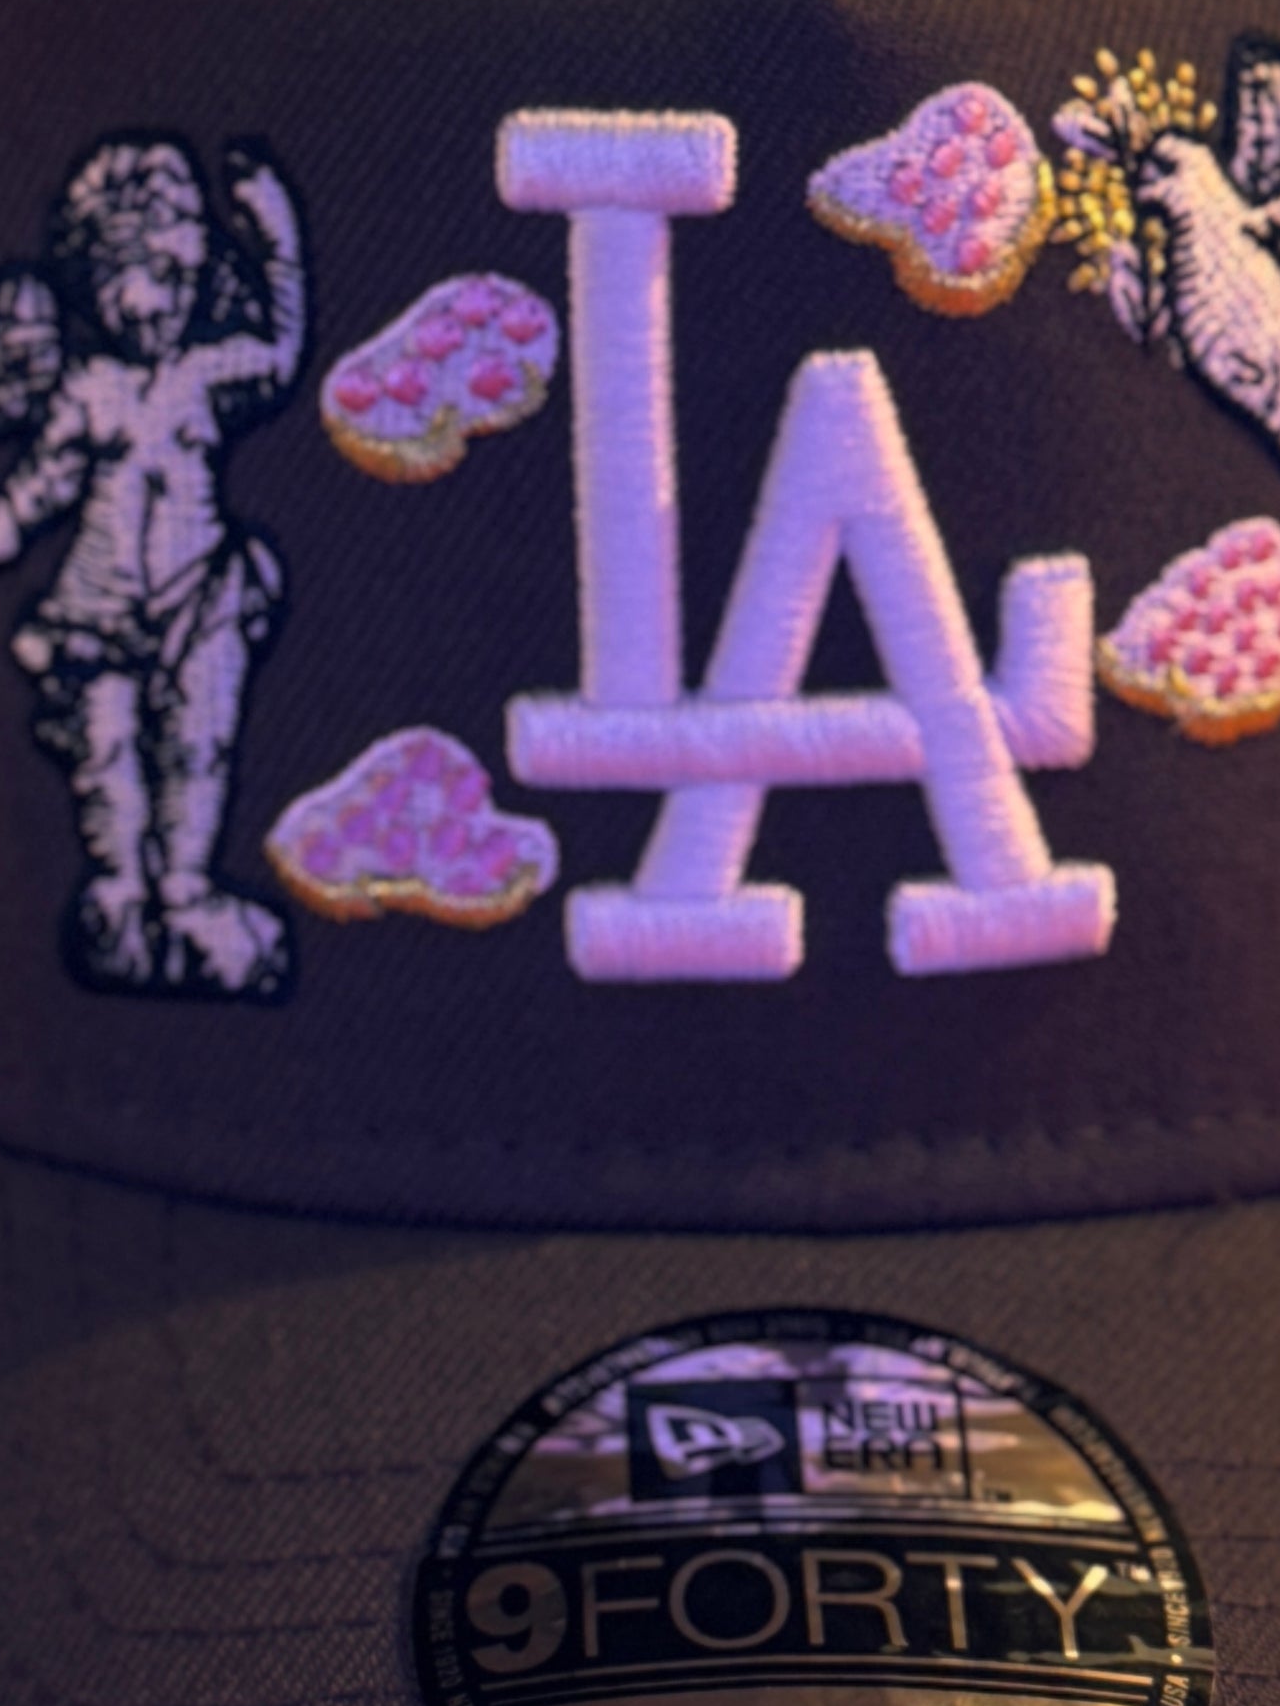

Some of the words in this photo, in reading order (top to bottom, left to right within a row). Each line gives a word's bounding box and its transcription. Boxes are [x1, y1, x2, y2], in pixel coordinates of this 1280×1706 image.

[497, 108, 1116, 980] LA
[824, 1399, 938, 1434] NEW
[825, 1435, 944, 1472] ERA
[466, 1548, 1109, 1673] 9FORTY
[1165, 1593, 1191, 1648] SINCE
